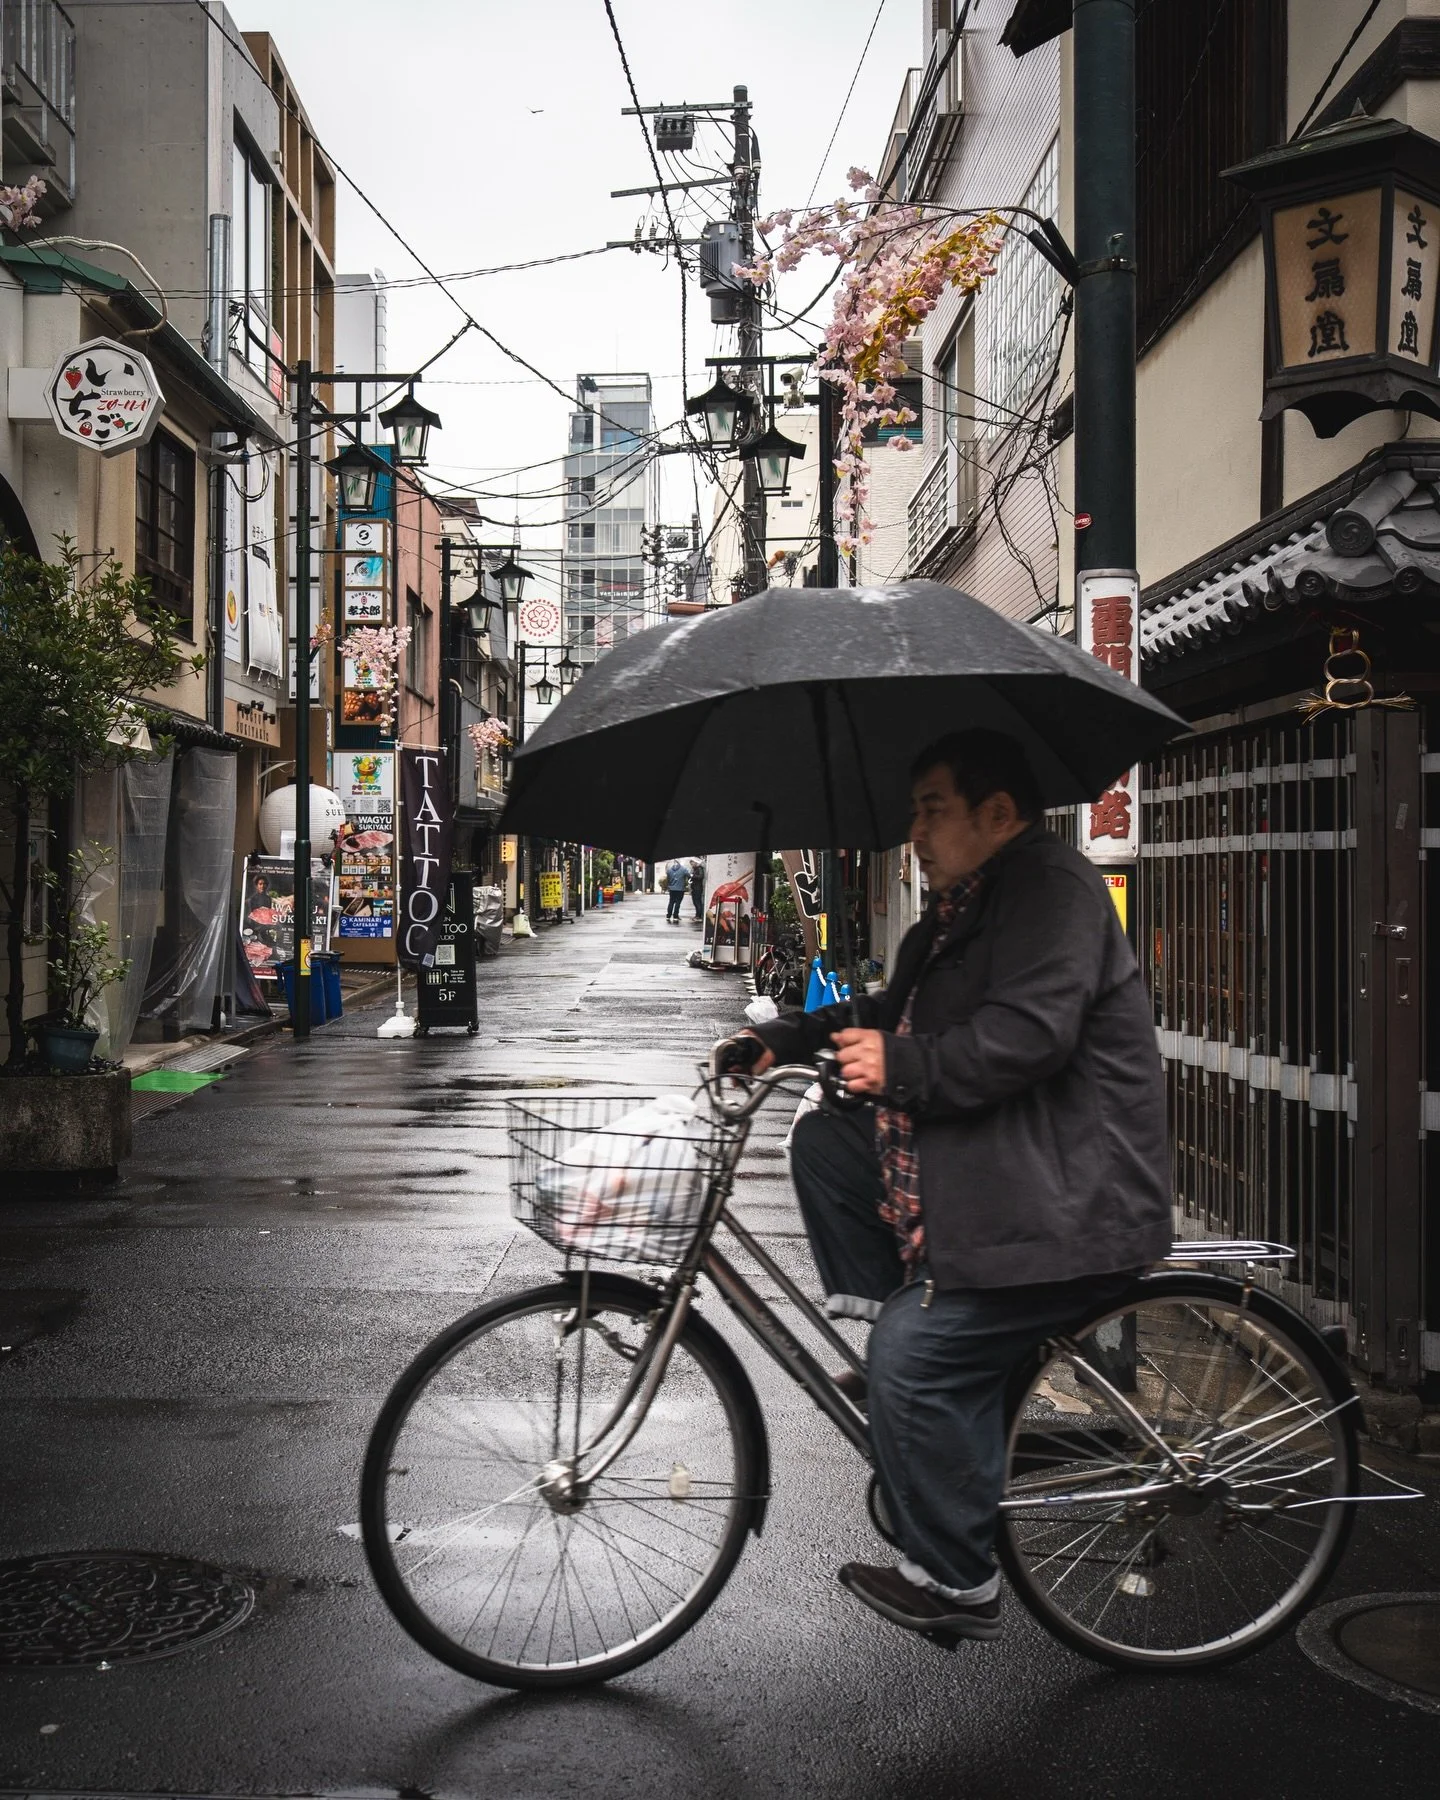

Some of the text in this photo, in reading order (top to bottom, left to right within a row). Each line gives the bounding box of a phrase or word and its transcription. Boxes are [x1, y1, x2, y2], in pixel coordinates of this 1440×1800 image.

[1305, 207, 1349, 357] 文扇堂
[1398, 204, 1428, 357] 文扇堂
[101, 389, 146, 397] Strawberry
[359, 816, 392, 824] WAGYU
[438, 988, 457, 1002] 5F
